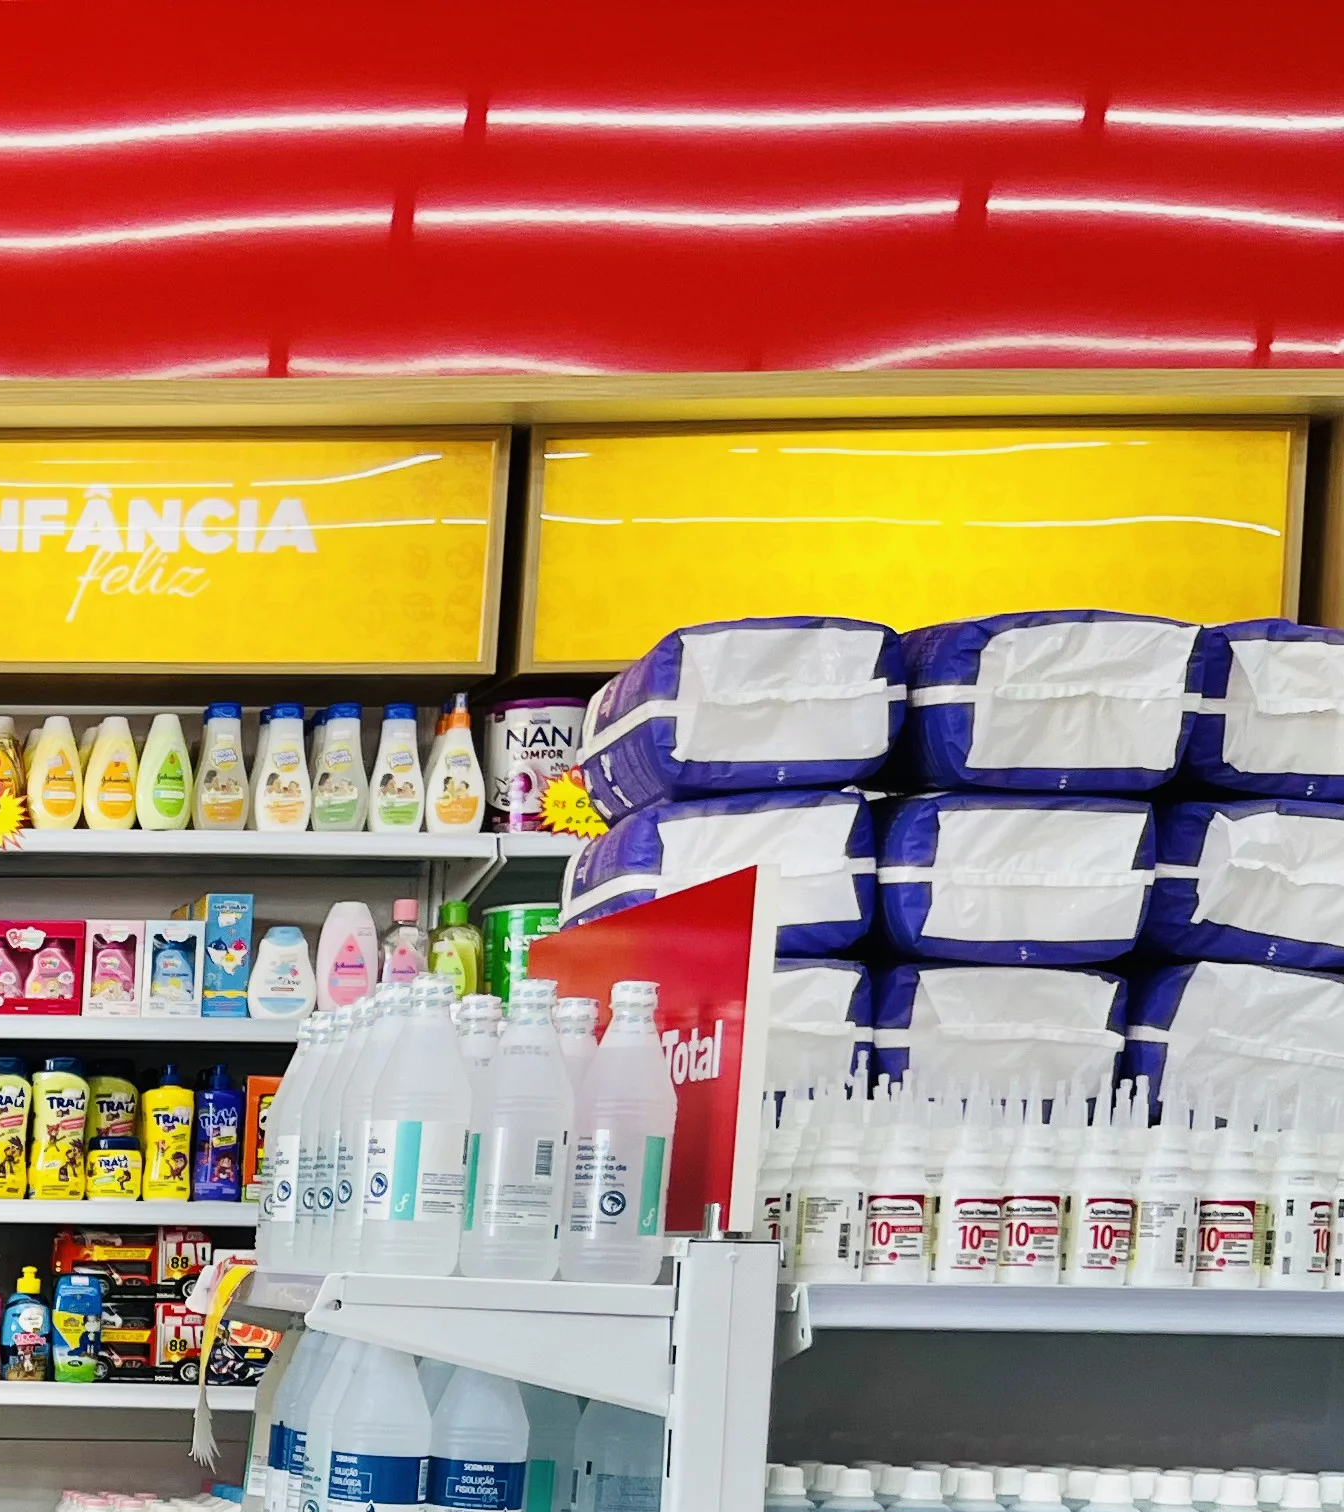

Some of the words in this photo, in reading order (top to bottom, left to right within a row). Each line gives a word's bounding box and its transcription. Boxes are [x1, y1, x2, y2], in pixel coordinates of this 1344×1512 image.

[66, 543, 211, 623] feliz
[507, 726, 572, 750] NAN
[870, 1221, 891, 1247] 10
[958, 1225, 982, 1250] 10
[1005, 1222, 1030, 1247] 10
[1090, 1224, 1113, 1250] 10
[1199, 1227, 1220, 1252] 10
[170, 1256, 188, 1270] 88
[169, 1339, 188, 1353] 88
[461, 1475, 495, 1487] SOLUÇÃO
